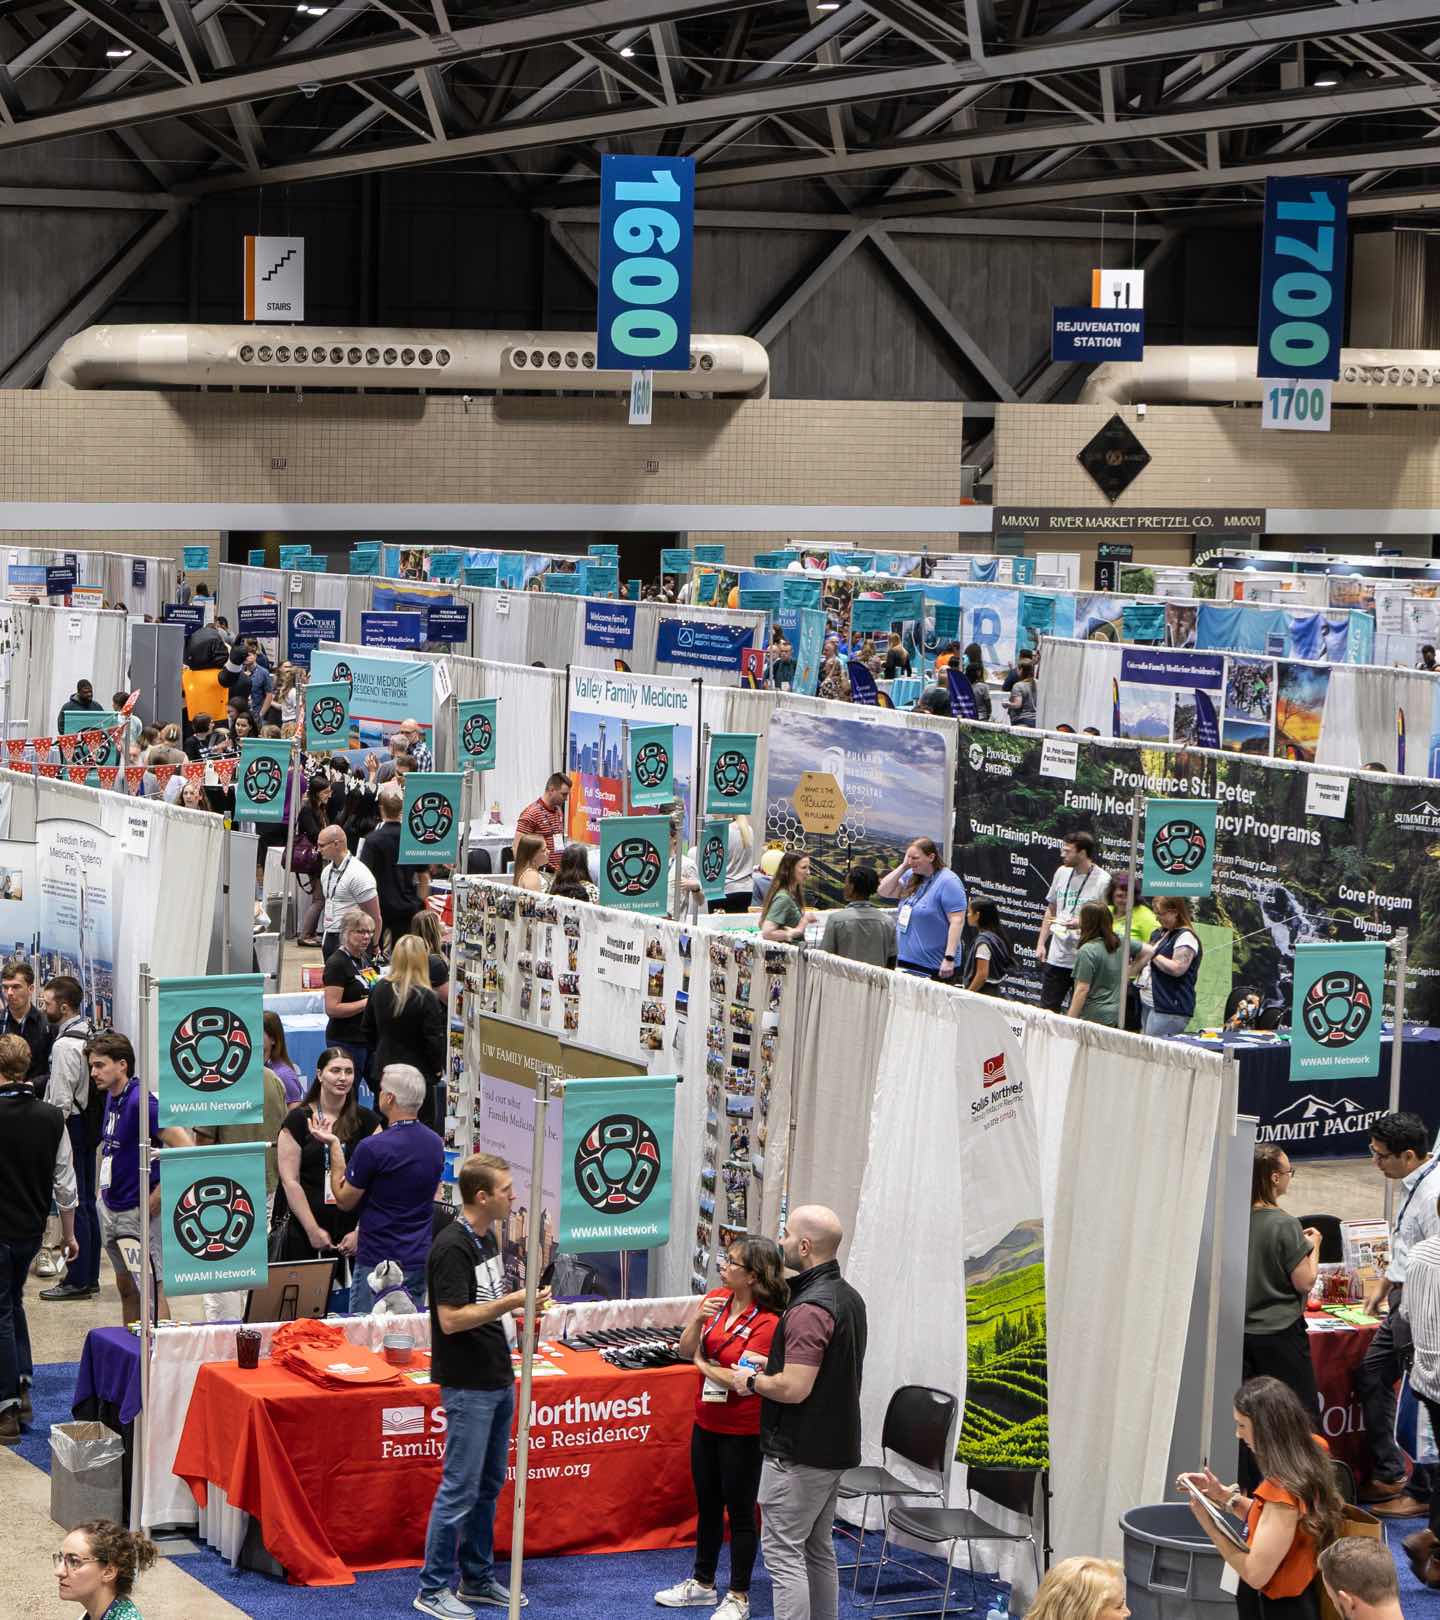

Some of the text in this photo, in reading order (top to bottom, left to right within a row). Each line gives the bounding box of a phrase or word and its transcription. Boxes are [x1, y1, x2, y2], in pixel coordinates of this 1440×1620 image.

[611, 170, 680, 357] 1600
[1270, 191, 1335, 366] 1700
[266, 301, 291, 312] STAIRS
[1056, 321, 1140, 334] REJUVENATION
[1073, 336, 1121, 348] STATION
[633, 380, 650, 415] 1600
[1269, 387, 1324, 422] 1700
[1001, 515, 1040, 527] MMXVI
[1049, 516, 1215, 528] RIVER MARKET PRETZEL CO.
[1224, 515, 1261, 527] MMXVI
[298, 616, 336, 627] Covenant
[590, 611, 629, 624] Welcome Family
[366, 635, 415, 644] Family Medicine
[353, 672, 407, 688] FAMILY MEDICINE
[381, 688, 408, 698] NETWORK
[575, 677, 688, 710] Valley Family Medicine
[986, 747, 1023, 764] Providence
[984, 763, 1013, 777] SWEDISH
[1112, 768, 1257, 805] Providence St. Peter
[1064, 790, 1102, 816] Family
[1394, 813, 1429, 825] SUMMIT
[969, 818, 994, 835] Rural
[995, 825, 1030, 845] Training
[1245, 815, 1321, 846] Programs
[56, 832, 97, 850] Swedish Family
[406, 849, 452, 858] WWAMI Network
[1010, 853, 1029, 866] Elma
[1235, 855, 1277, 872] Primary Care
[1219, 870, 1229, 879] on
[1338, 884, 1412, 911] Core Progam
[1353, 916, 1392, 935] Olympia
[1013, 943, 1037, 958] Cheha
[482, 1042, 523, 1067] UW FAMILY
[1300, 1055, 1370, 1067] WWAMI Network
[170, 1100, 252, 1113] WWAMI Network
[495, 1093, 506, 1105] out
[488, 1107, 509, 1126] Family
[1255, 1119, 1319, 1143] UMMIT
[571, 1223, 658, 1238] WWAMI Network
[174, 1267, 257, 1283] WWAMI Network
[381, 1423, 651, 1459] Family Residency
